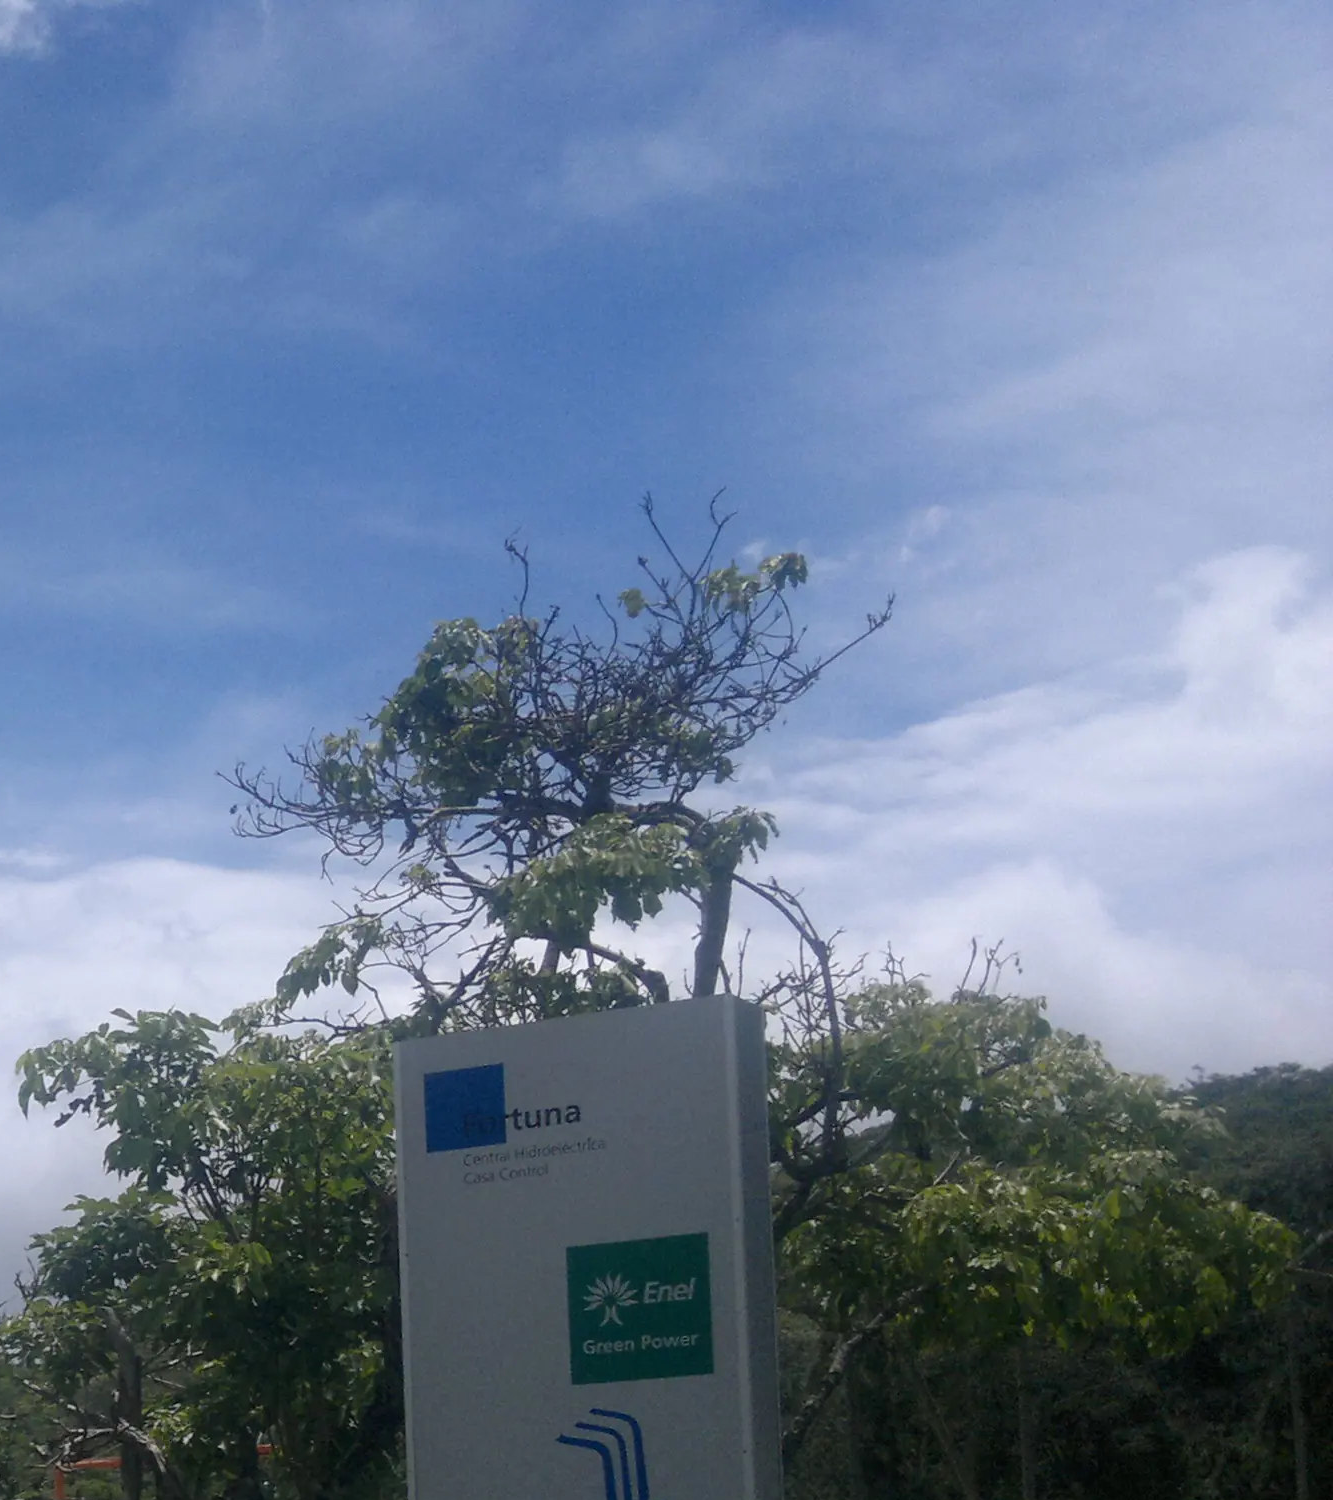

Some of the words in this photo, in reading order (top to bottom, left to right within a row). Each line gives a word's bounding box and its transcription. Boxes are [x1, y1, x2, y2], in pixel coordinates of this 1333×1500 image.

[462, 1152, 510, 1168] Central
[463, 1171, 495, 1185] Casa
[499, 1164, 550, 1182] Control
[642, 1278, 697, 1304] Enel
[583, 1339, 635, 1354] Green
[641, 1334, 700, 1350] Power
